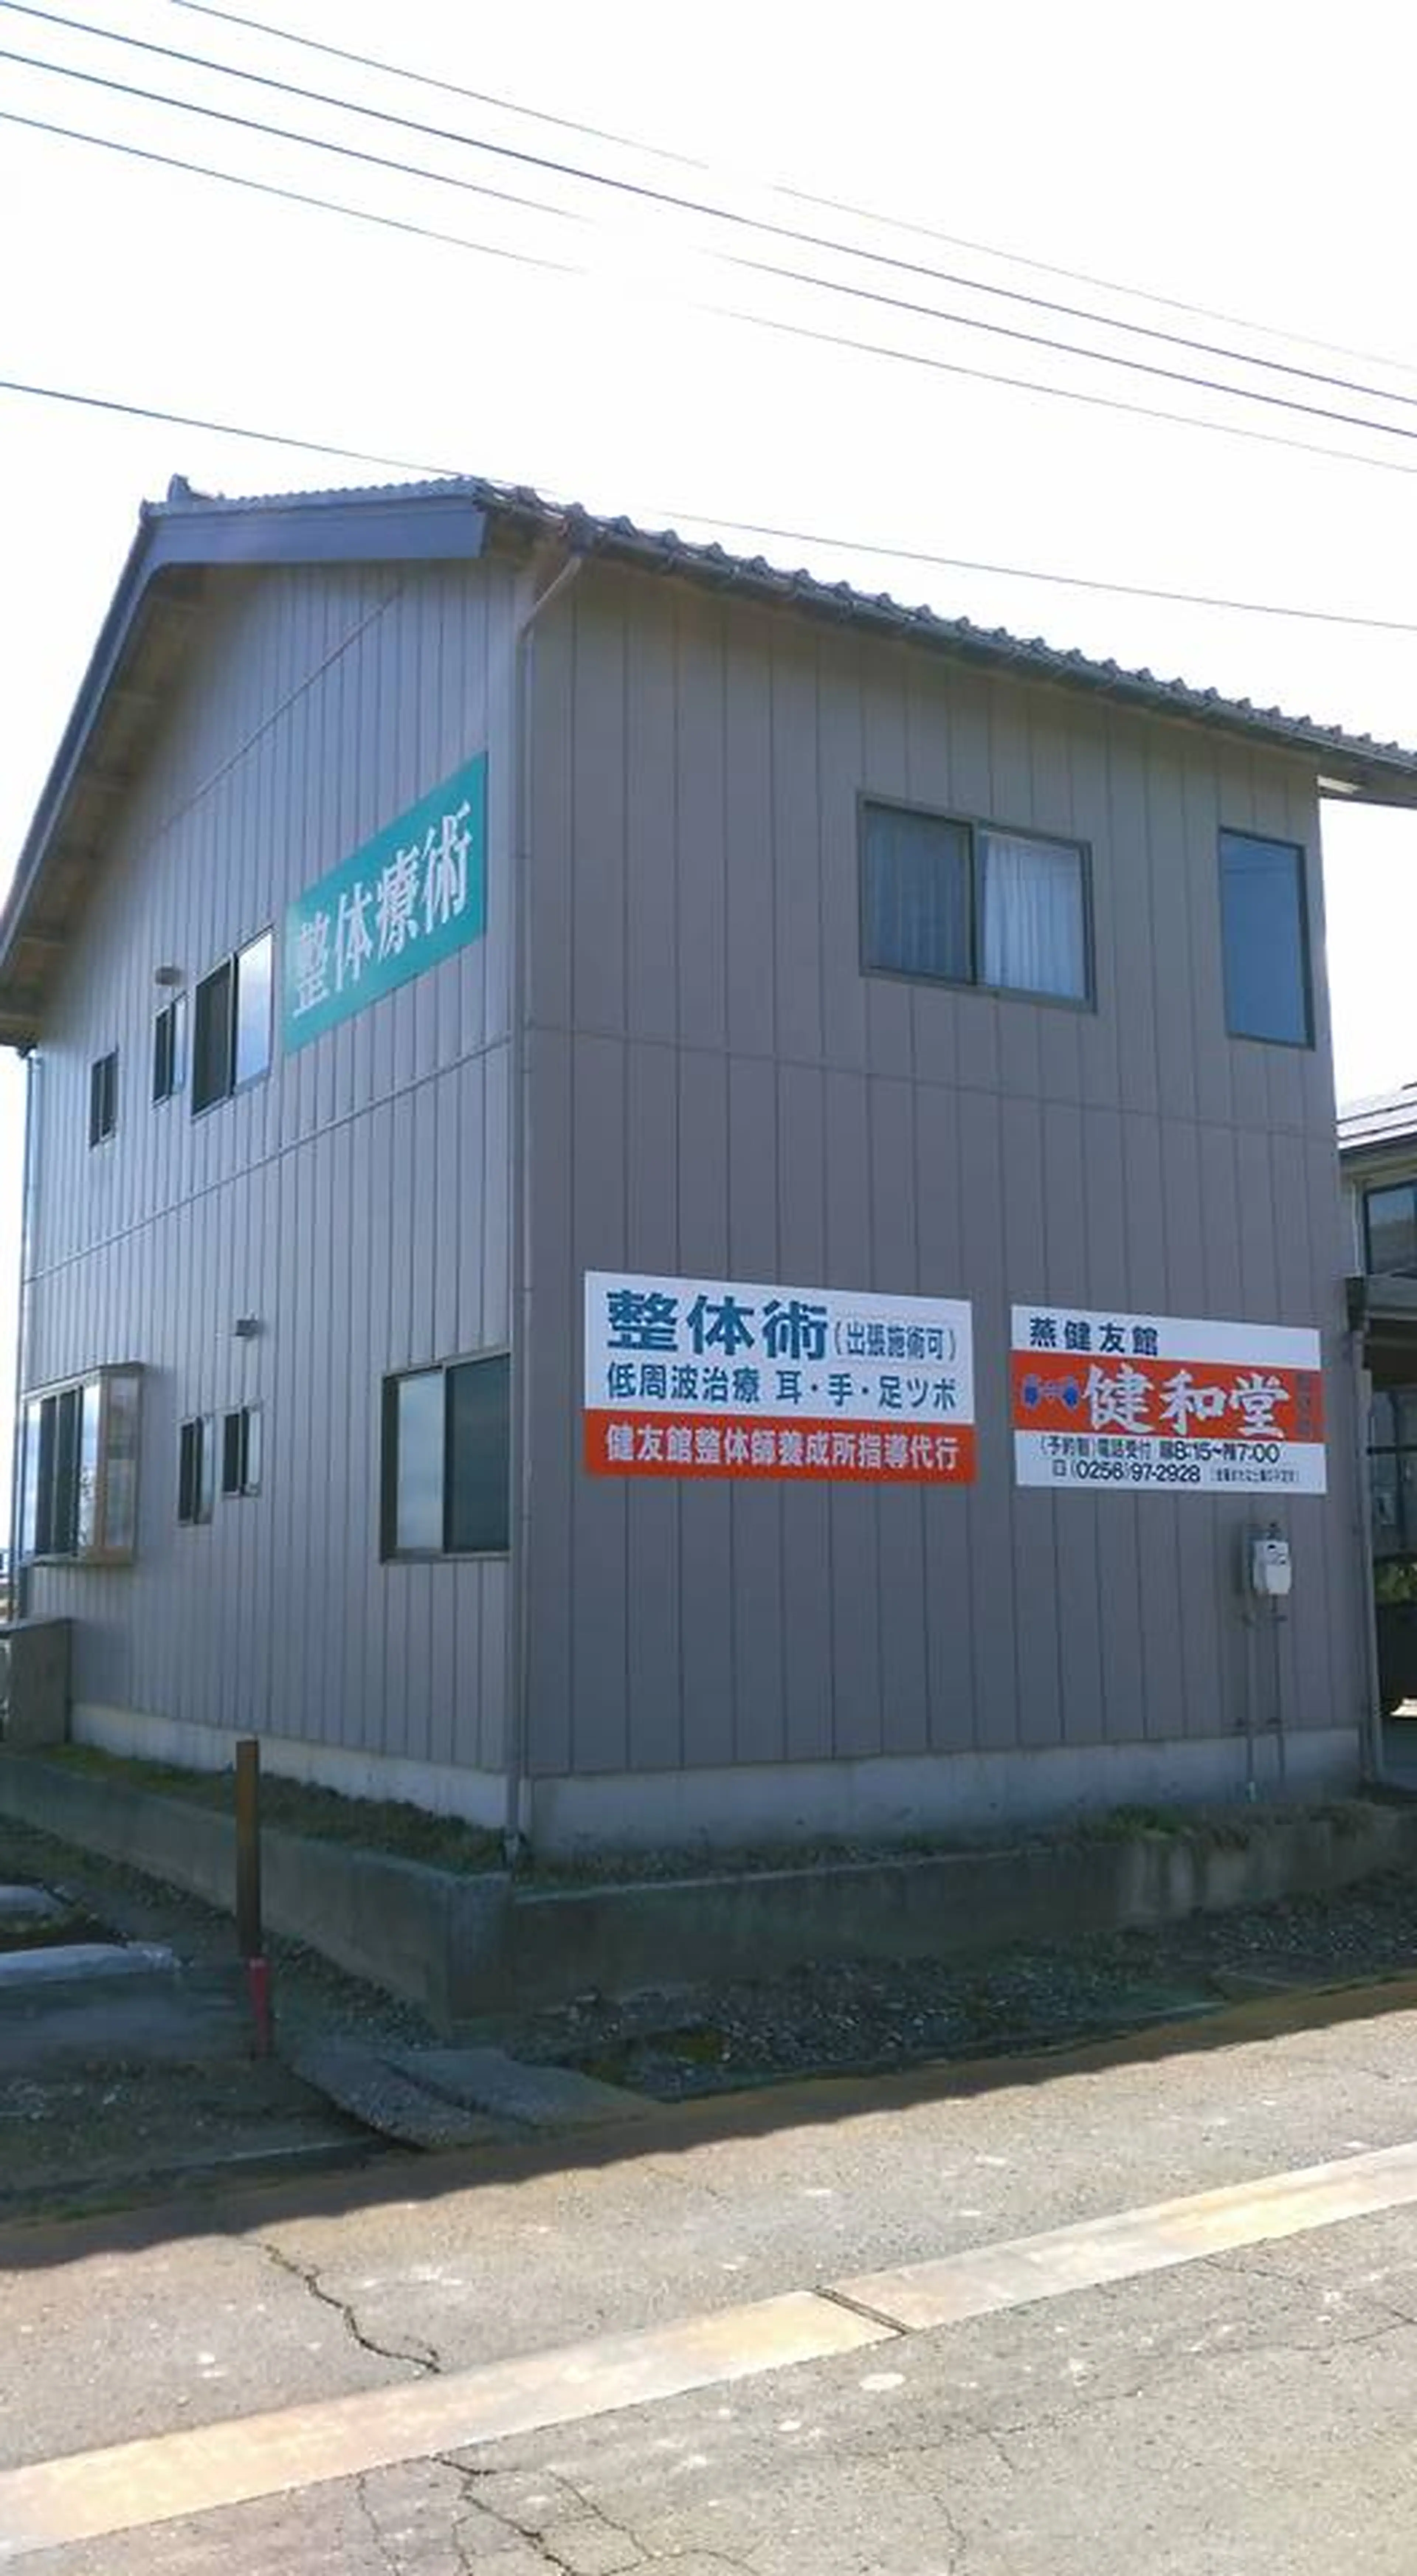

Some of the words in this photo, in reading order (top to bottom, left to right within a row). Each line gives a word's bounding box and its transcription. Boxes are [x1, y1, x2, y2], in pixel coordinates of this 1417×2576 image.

[293, 800, 472, 1018] 整体療術
[606, 1289, 828, 1361] 整体術
[607, 1362, 761, 1404] 低周波治療
[1082, 1362, 1290, 1439] 健和堂
[607, 1423, 960, 1470] 健友館整体師養成所指導代行
